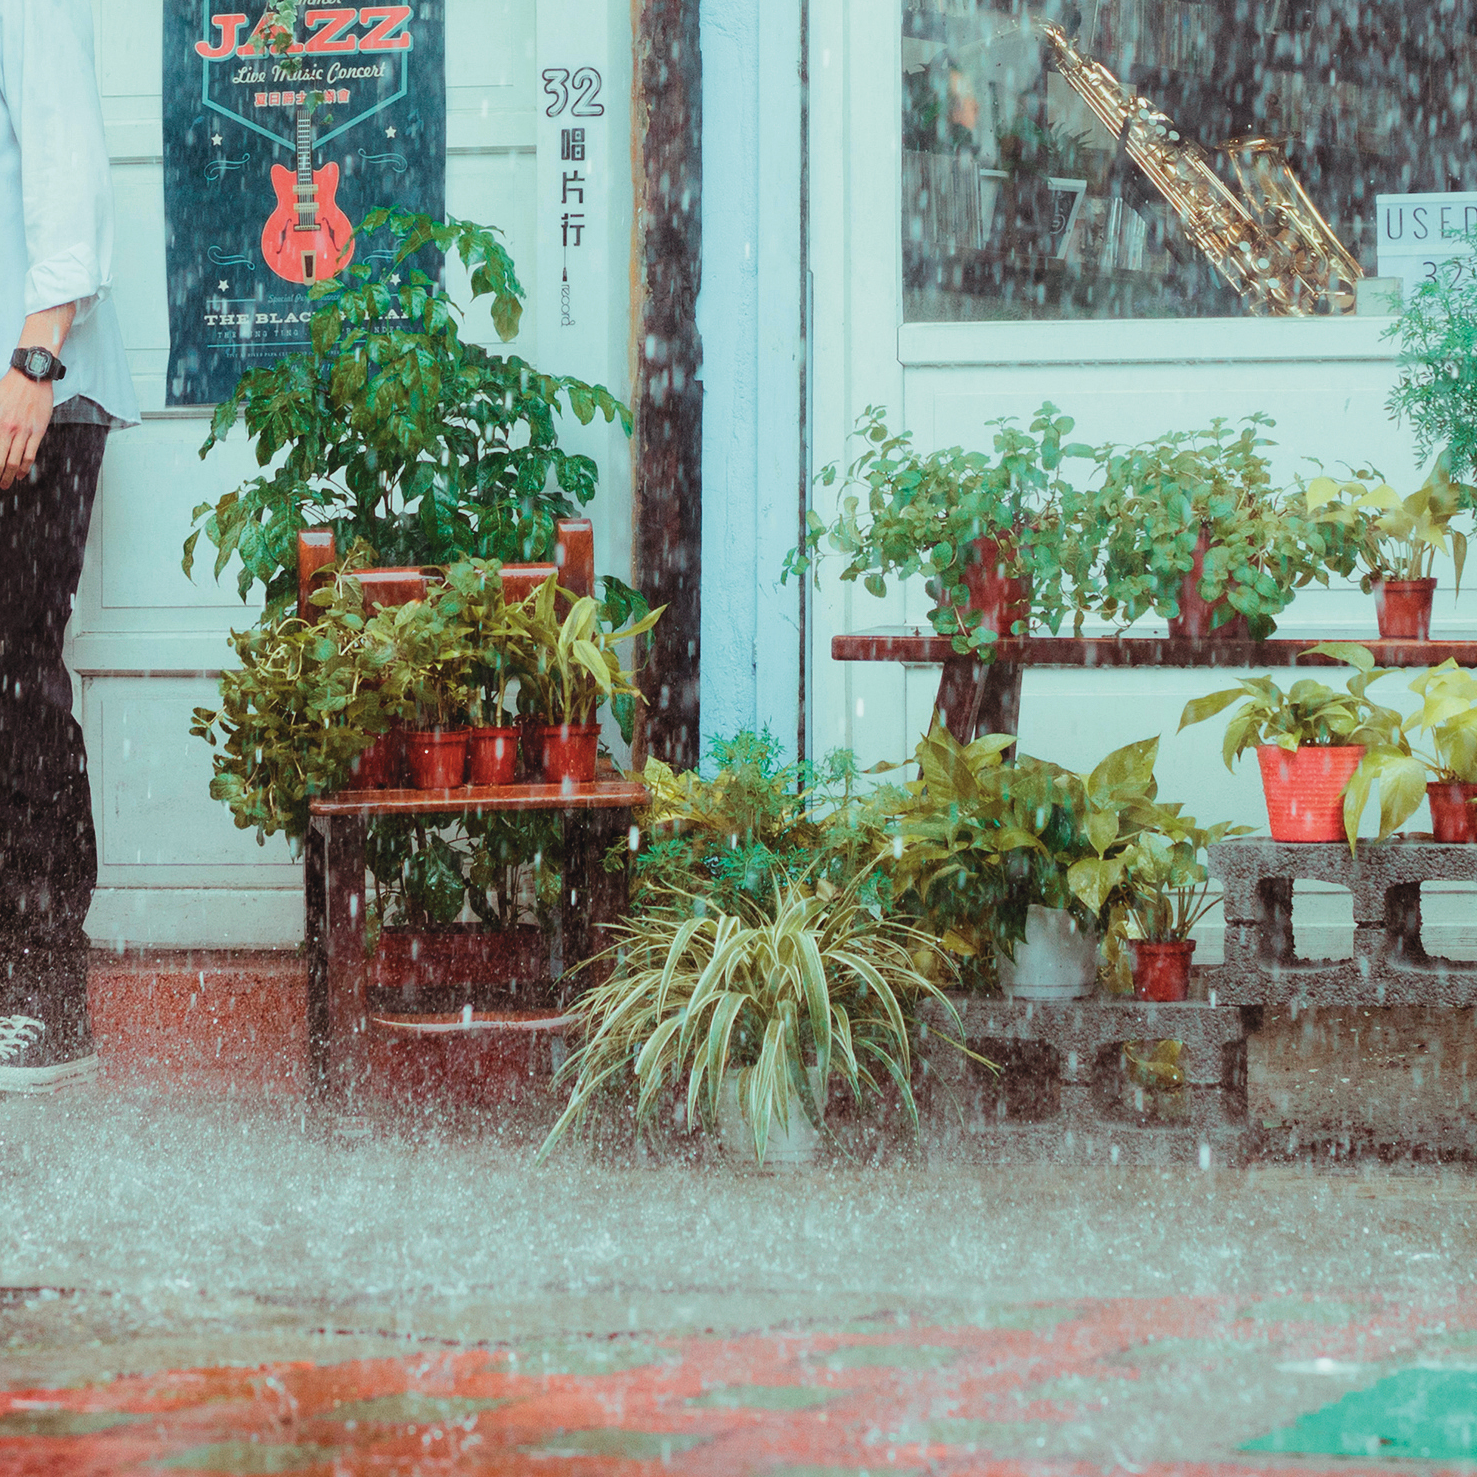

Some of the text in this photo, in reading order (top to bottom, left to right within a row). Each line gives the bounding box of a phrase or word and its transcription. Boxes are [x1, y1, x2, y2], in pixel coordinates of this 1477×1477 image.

[195, 5, 413, 62] JAZZ
[232, 61, 386, 84] Live Music Concert
[542, 67, 605, 117] 32
[254, 88, 351, 108] 夏日爵士樂會
[561, 128, 586, 246] 唱片行
[204, 312, 313, 326] THE BLAC
[561, 284, 576, 327] record
